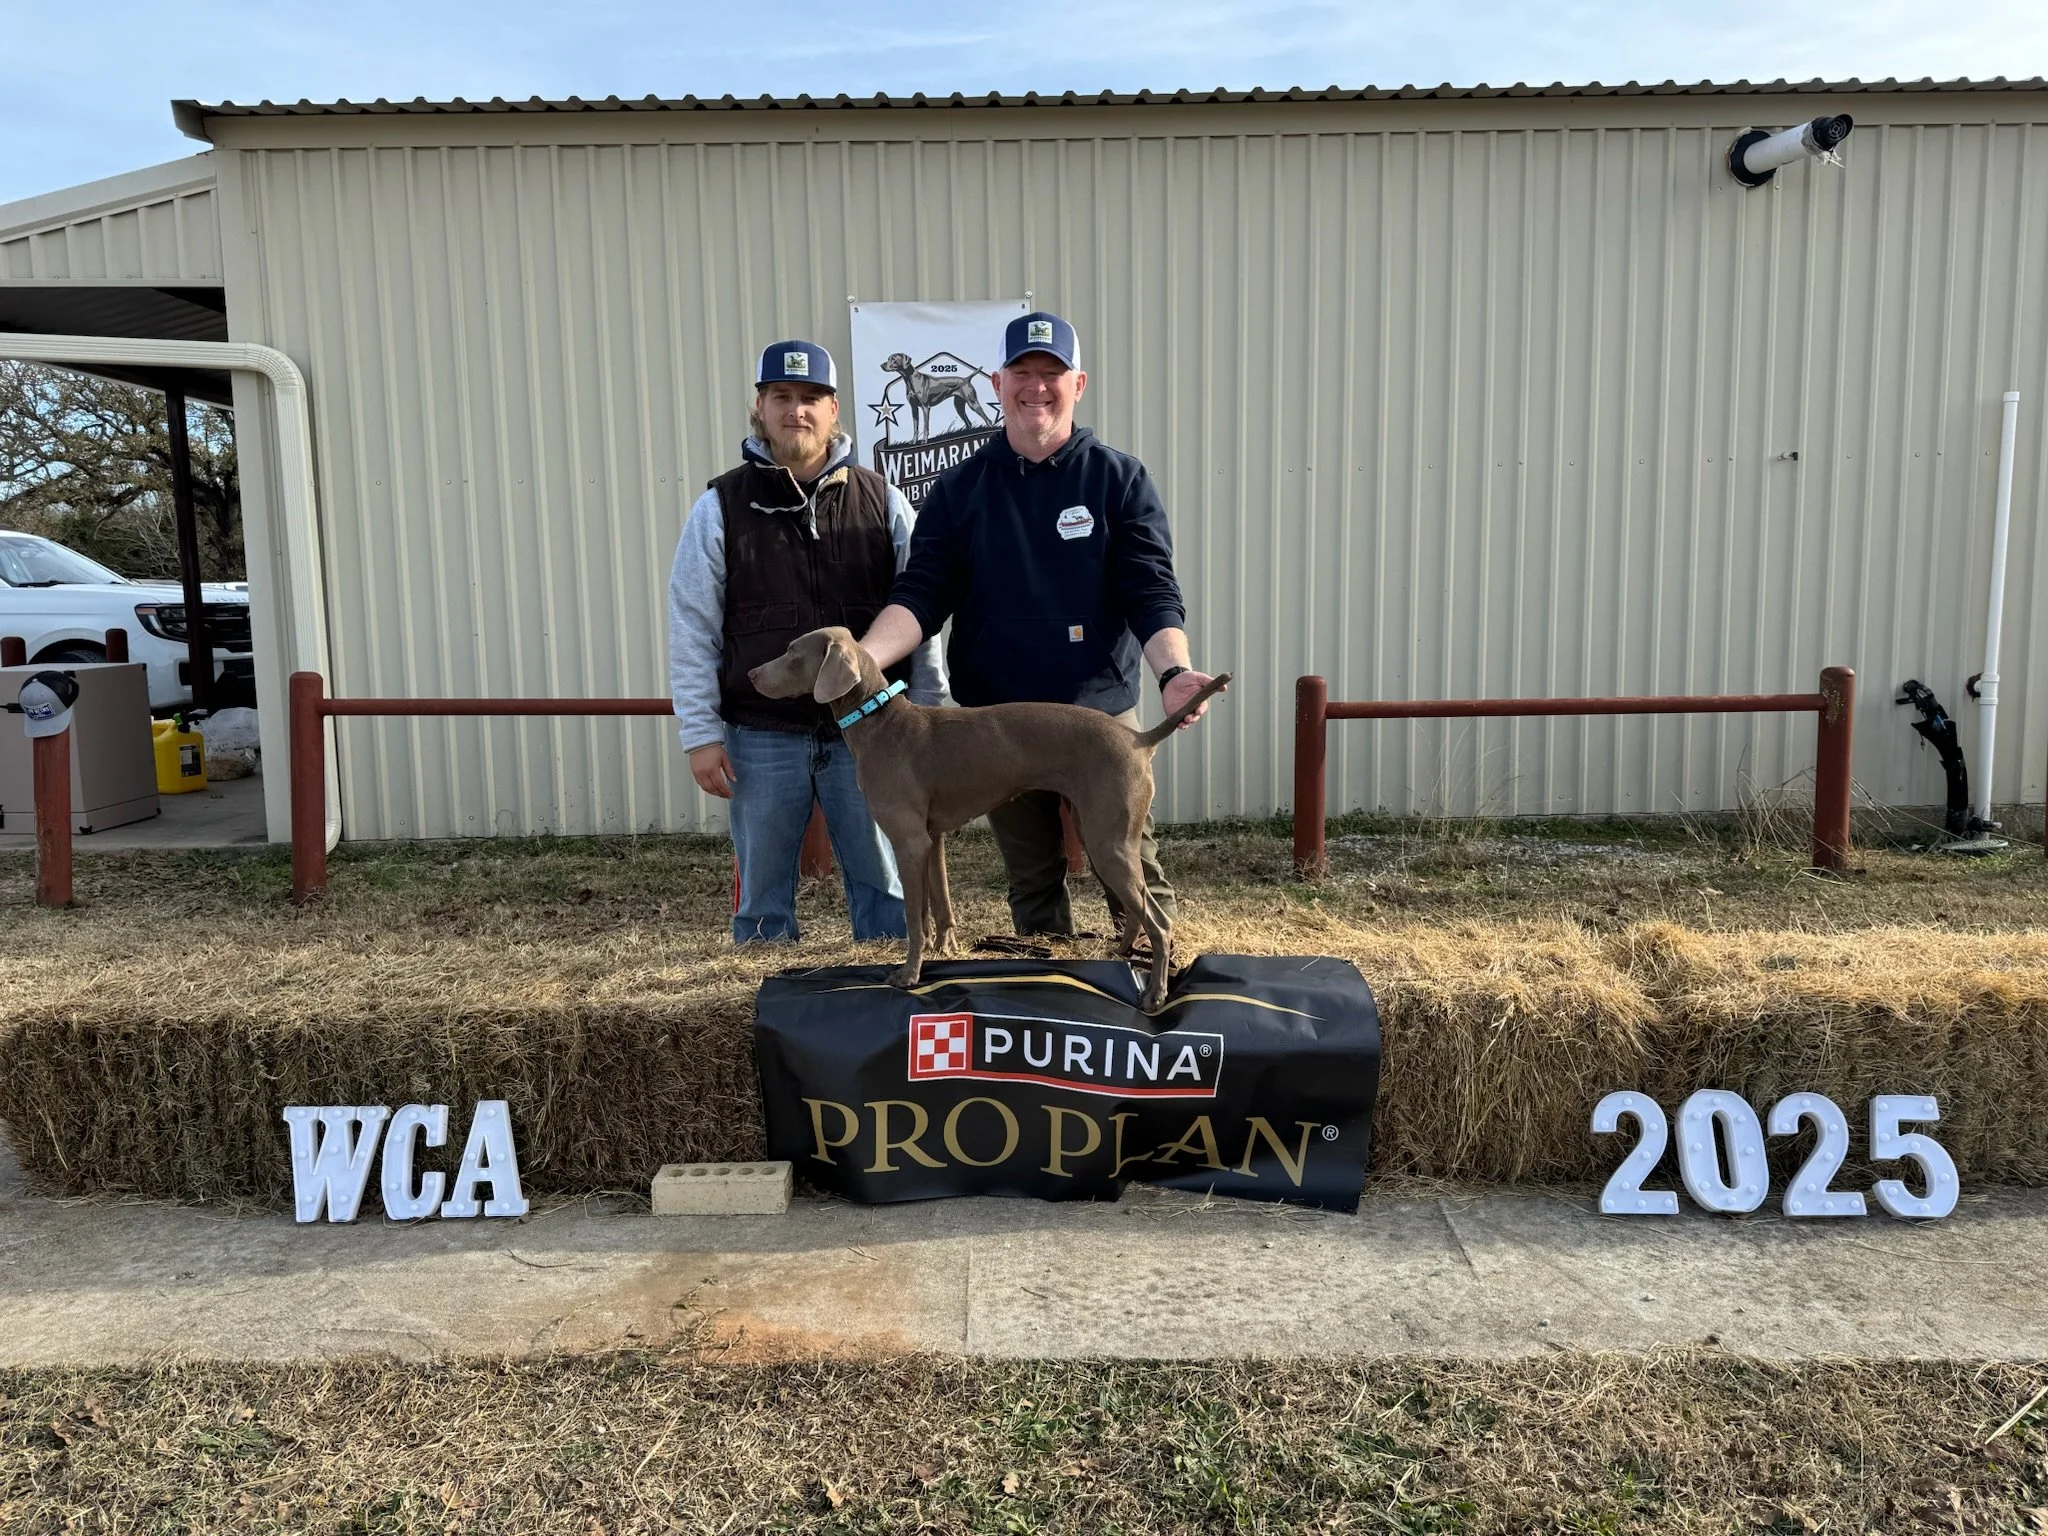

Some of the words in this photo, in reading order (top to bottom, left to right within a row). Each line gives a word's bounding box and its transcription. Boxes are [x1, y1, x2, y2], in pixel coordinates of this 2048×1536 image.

[931, 365, 958, 373] 2025
[880, 437, 990, 486] WEIMARAN
[902, 485, 920, 502] UB
[282, 1099, 530, 1224] WCA
[801, 1096, 1020, 1174] PRO
[1590, 1088, 1960, 1219] 2025
